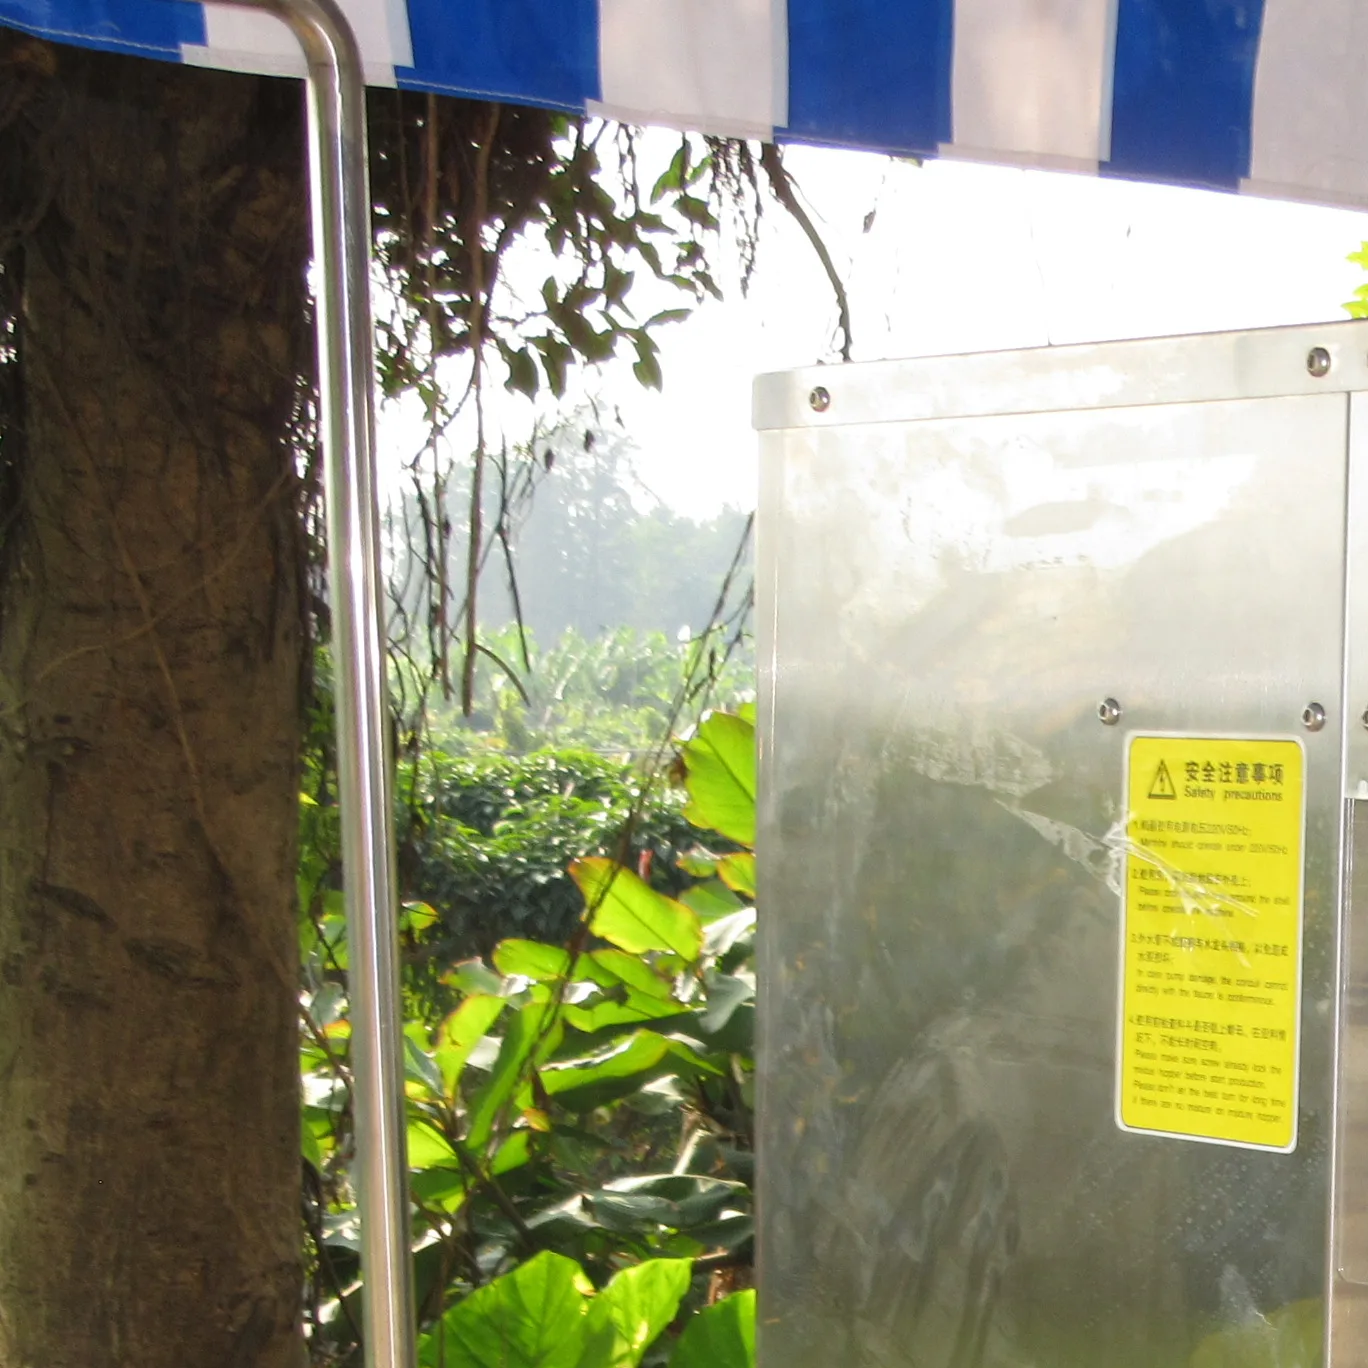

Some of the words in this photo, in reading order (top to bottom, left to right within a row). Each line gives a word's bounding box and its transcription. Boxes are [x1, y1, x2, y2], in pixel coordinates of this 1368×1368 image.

[1184, 760, 1284, 785] 安全注意事项
[1184, 785, 1215, 801] Safety
[1223, 788, 1283, 802] precautions
